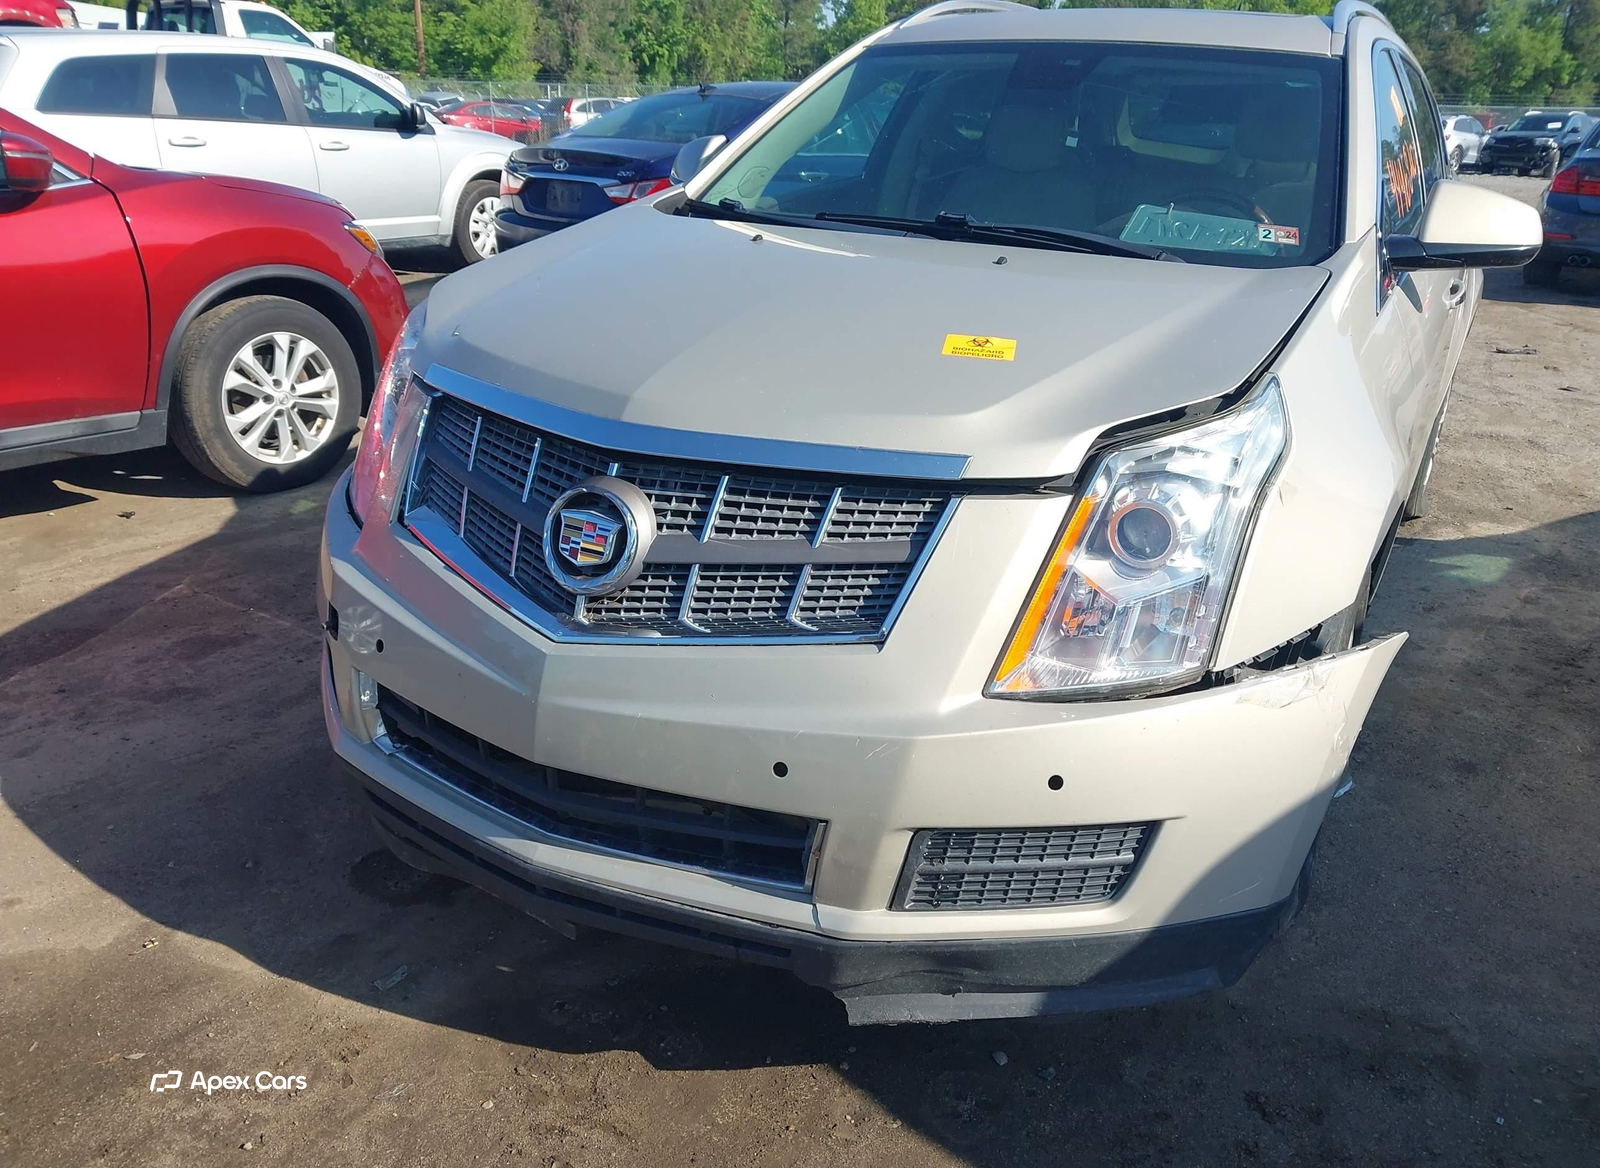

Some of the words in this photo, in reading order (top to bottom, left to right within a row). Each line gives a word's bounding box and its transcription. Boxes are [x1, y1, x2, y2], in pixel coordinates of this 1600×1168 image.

[1262, 229, 1272, 239] 2
[1285, 231, 1298, 240] 24
[952, 347, 1005, 355] BIOHAZARD
